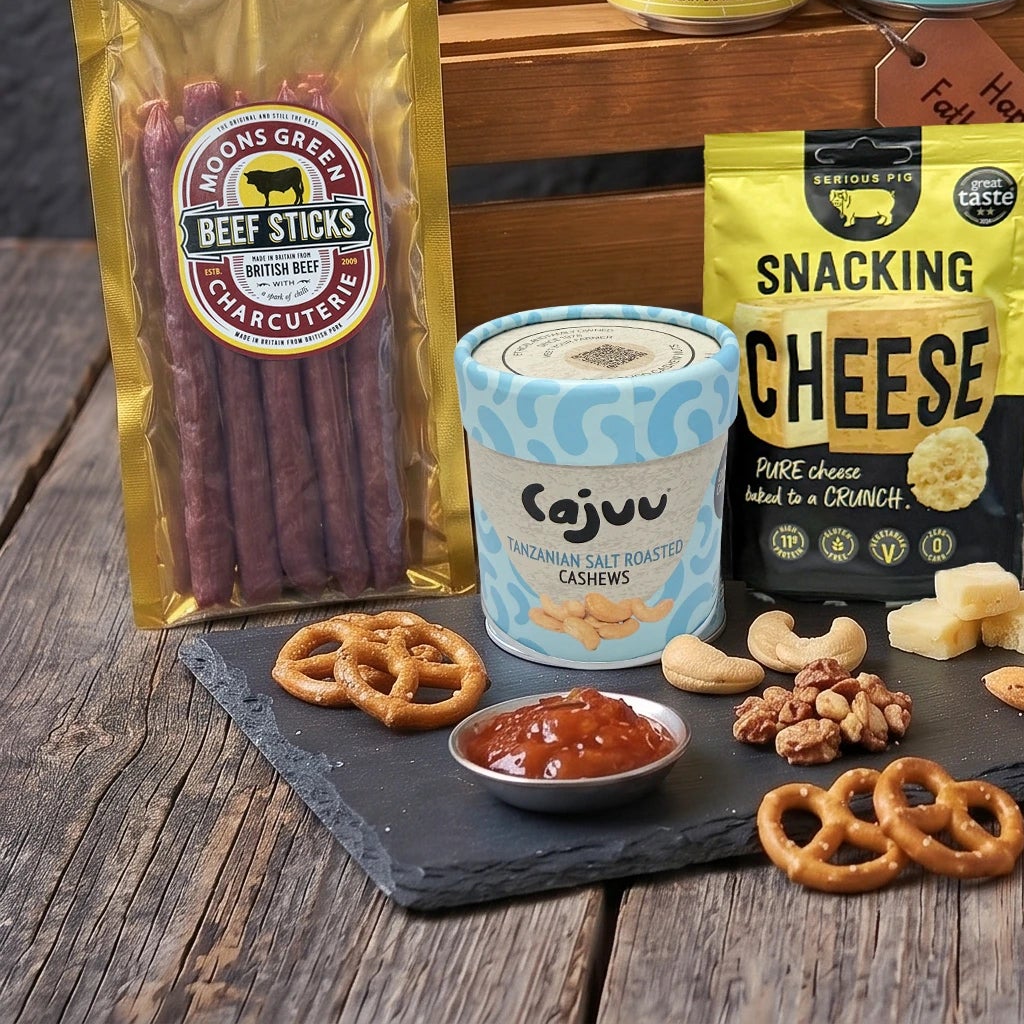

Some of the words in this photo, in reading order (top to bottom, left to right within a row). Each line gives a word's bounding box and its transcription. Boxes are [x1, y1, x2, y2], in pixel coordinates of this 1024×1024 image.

[229, 114, 257, 126] ORIGINAL
[199, 128, 268, 193] MOONS
[274, 128, 346, 182] GREEN
[813, 174, 880, 185] SERIOUS
[887, 172, 913, 183] PIG
[970, 178, 1003, 191] great
[958, 187, 1015, 207] taste
[196, 214, 260, 249] BEEF
[268, 207, 356, 243] STICKS
[275, 253, 296, 261] BRITAIN
[297, 251, 311, 259] FROM
[341, 257, 358, 266] 2009
[245, 262, 290, 278] BRITISH
[293, 259, 320, 275] BEEF
[757, 251, 974, 294] SNACKING
[208, 273, 358, 331] CHARCUTERIE
[234, 331, 251, 343] MADE
[745, 326, 989, 431] CHEESE
[755, 457, 805, 479] PURE
[808, 459, 861, 481] cheese
[744, 485, 782, 506] baked
[787, 488, 802, 506] to
[807, 495, 818, 506] a
[823, 485, 911, 510] CRUNCH.
[521, 482, 668, 544] Cajuu
[507, 536, 580, 568] TANZANIAN
[585, 553, 620, 570] SALT
[624, 539, 684, 566] ROASTED
[558, 570, 631, 586] CASHEWS
